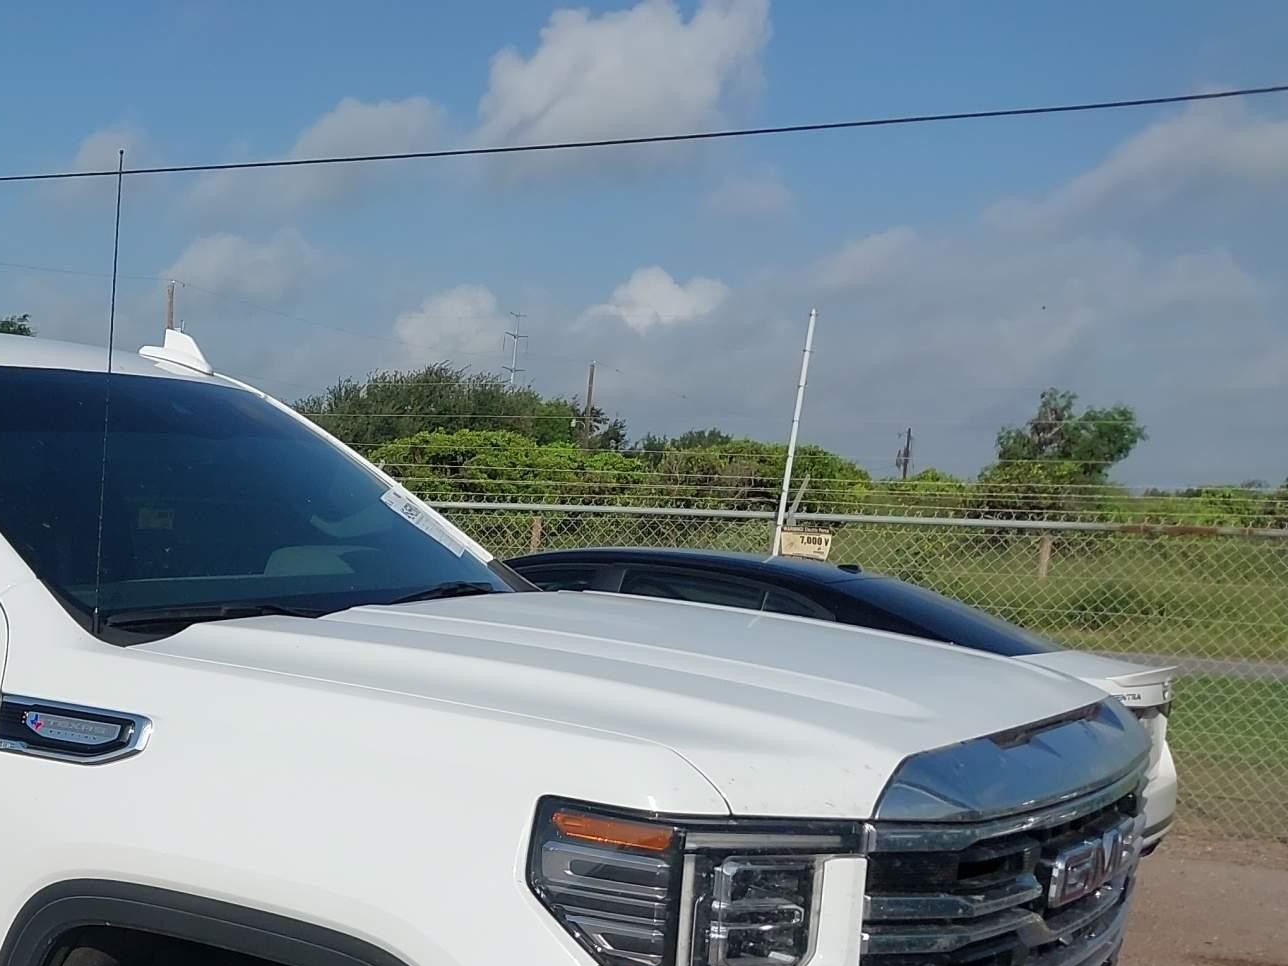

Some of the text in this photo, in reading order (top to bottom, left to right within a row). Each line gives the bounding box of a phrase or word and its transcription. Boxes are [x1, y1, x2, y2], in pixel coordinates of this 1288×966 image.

[800, 536, 829, 546] 7,000 V
[1048, 814, 1146, 908] GMC
